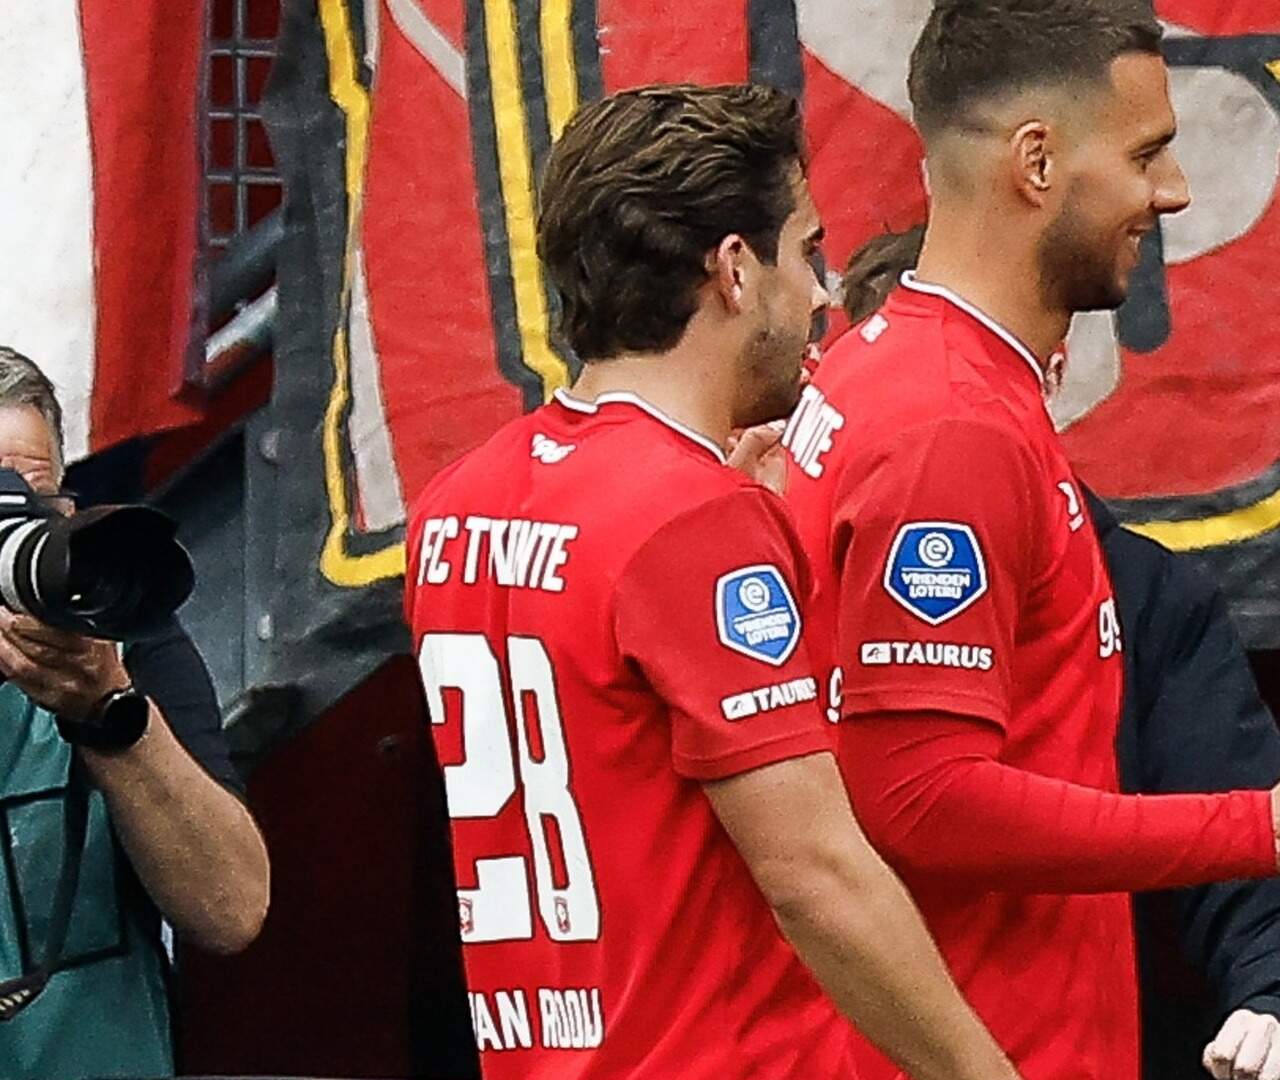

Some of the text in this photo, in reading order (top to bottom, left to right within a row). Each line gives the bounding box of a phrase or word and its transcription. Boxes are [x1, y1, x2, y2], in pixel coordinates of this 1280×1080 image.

[417, 516, 459, 586] FC
[891, 641, 993, 671] TAURUS
[419, 632, 601, 944] 28
[467, 989, 533, 1050] AN
